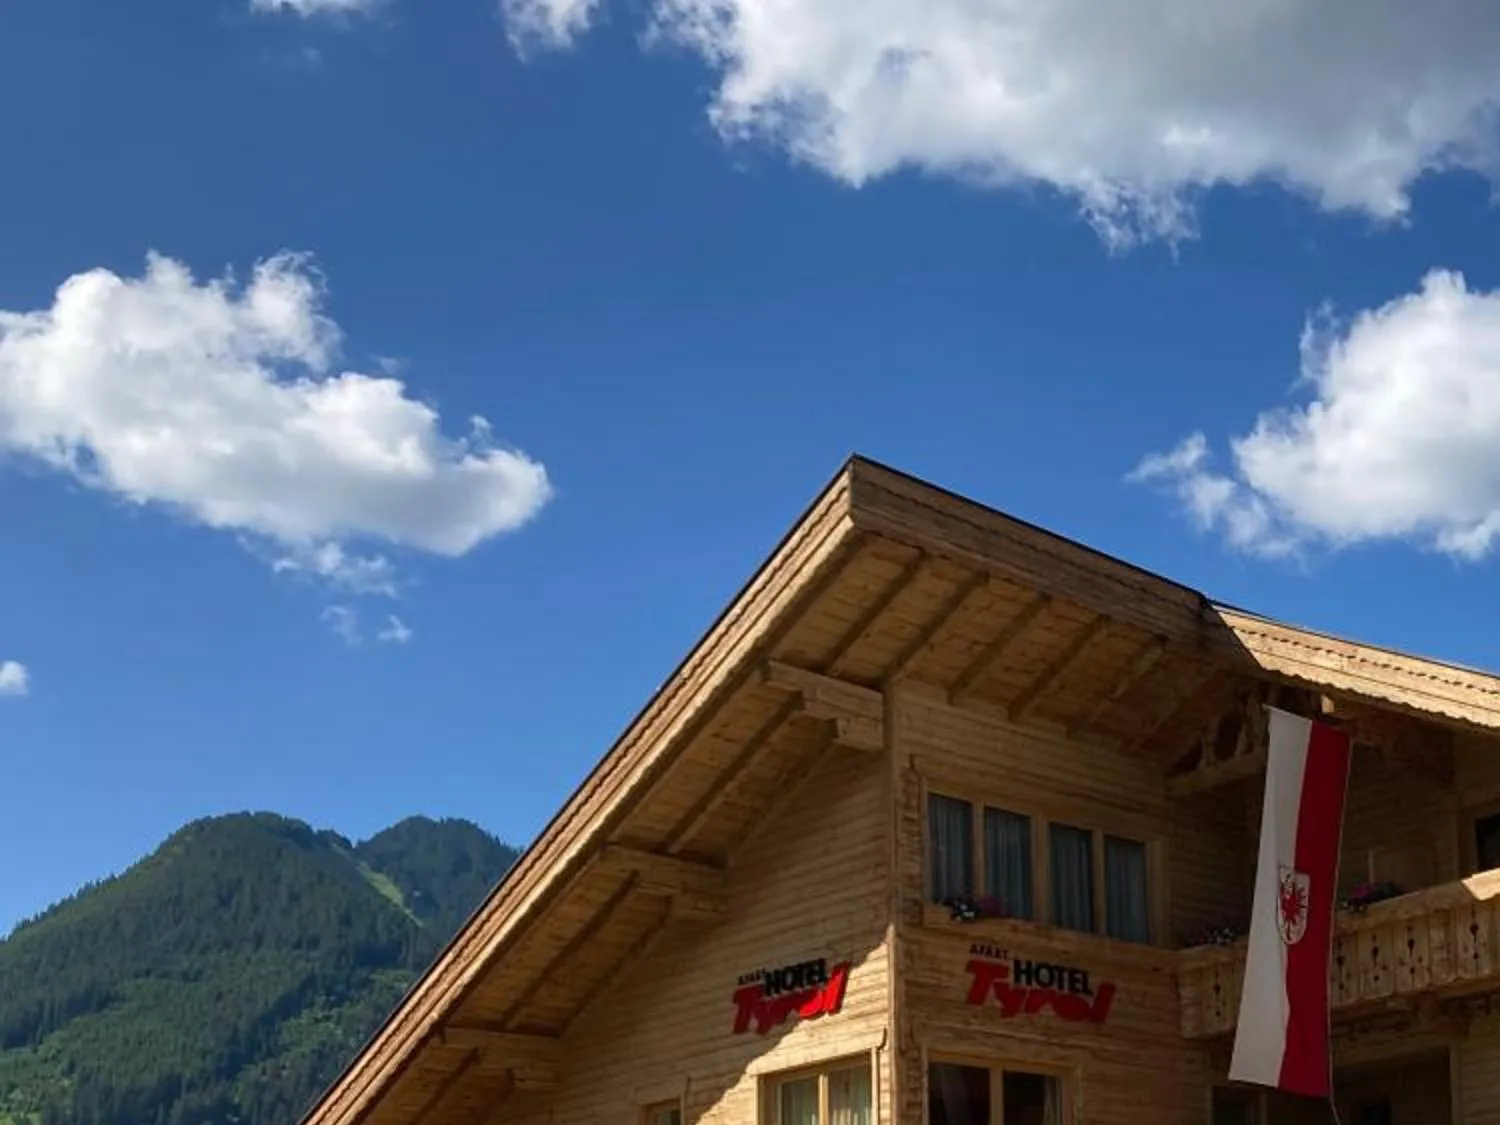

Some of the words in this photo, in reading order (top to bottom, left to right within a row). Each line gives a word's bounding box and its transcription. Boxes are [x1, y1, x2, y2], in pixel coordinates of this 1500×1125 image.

[732, 960, 852, 1035] Tyrol
[764, 958, 828, 997] HOTEL
[965, 959, 1117, 1025] Tyrol
[1012, 958, 1093, 996] HOTEL
